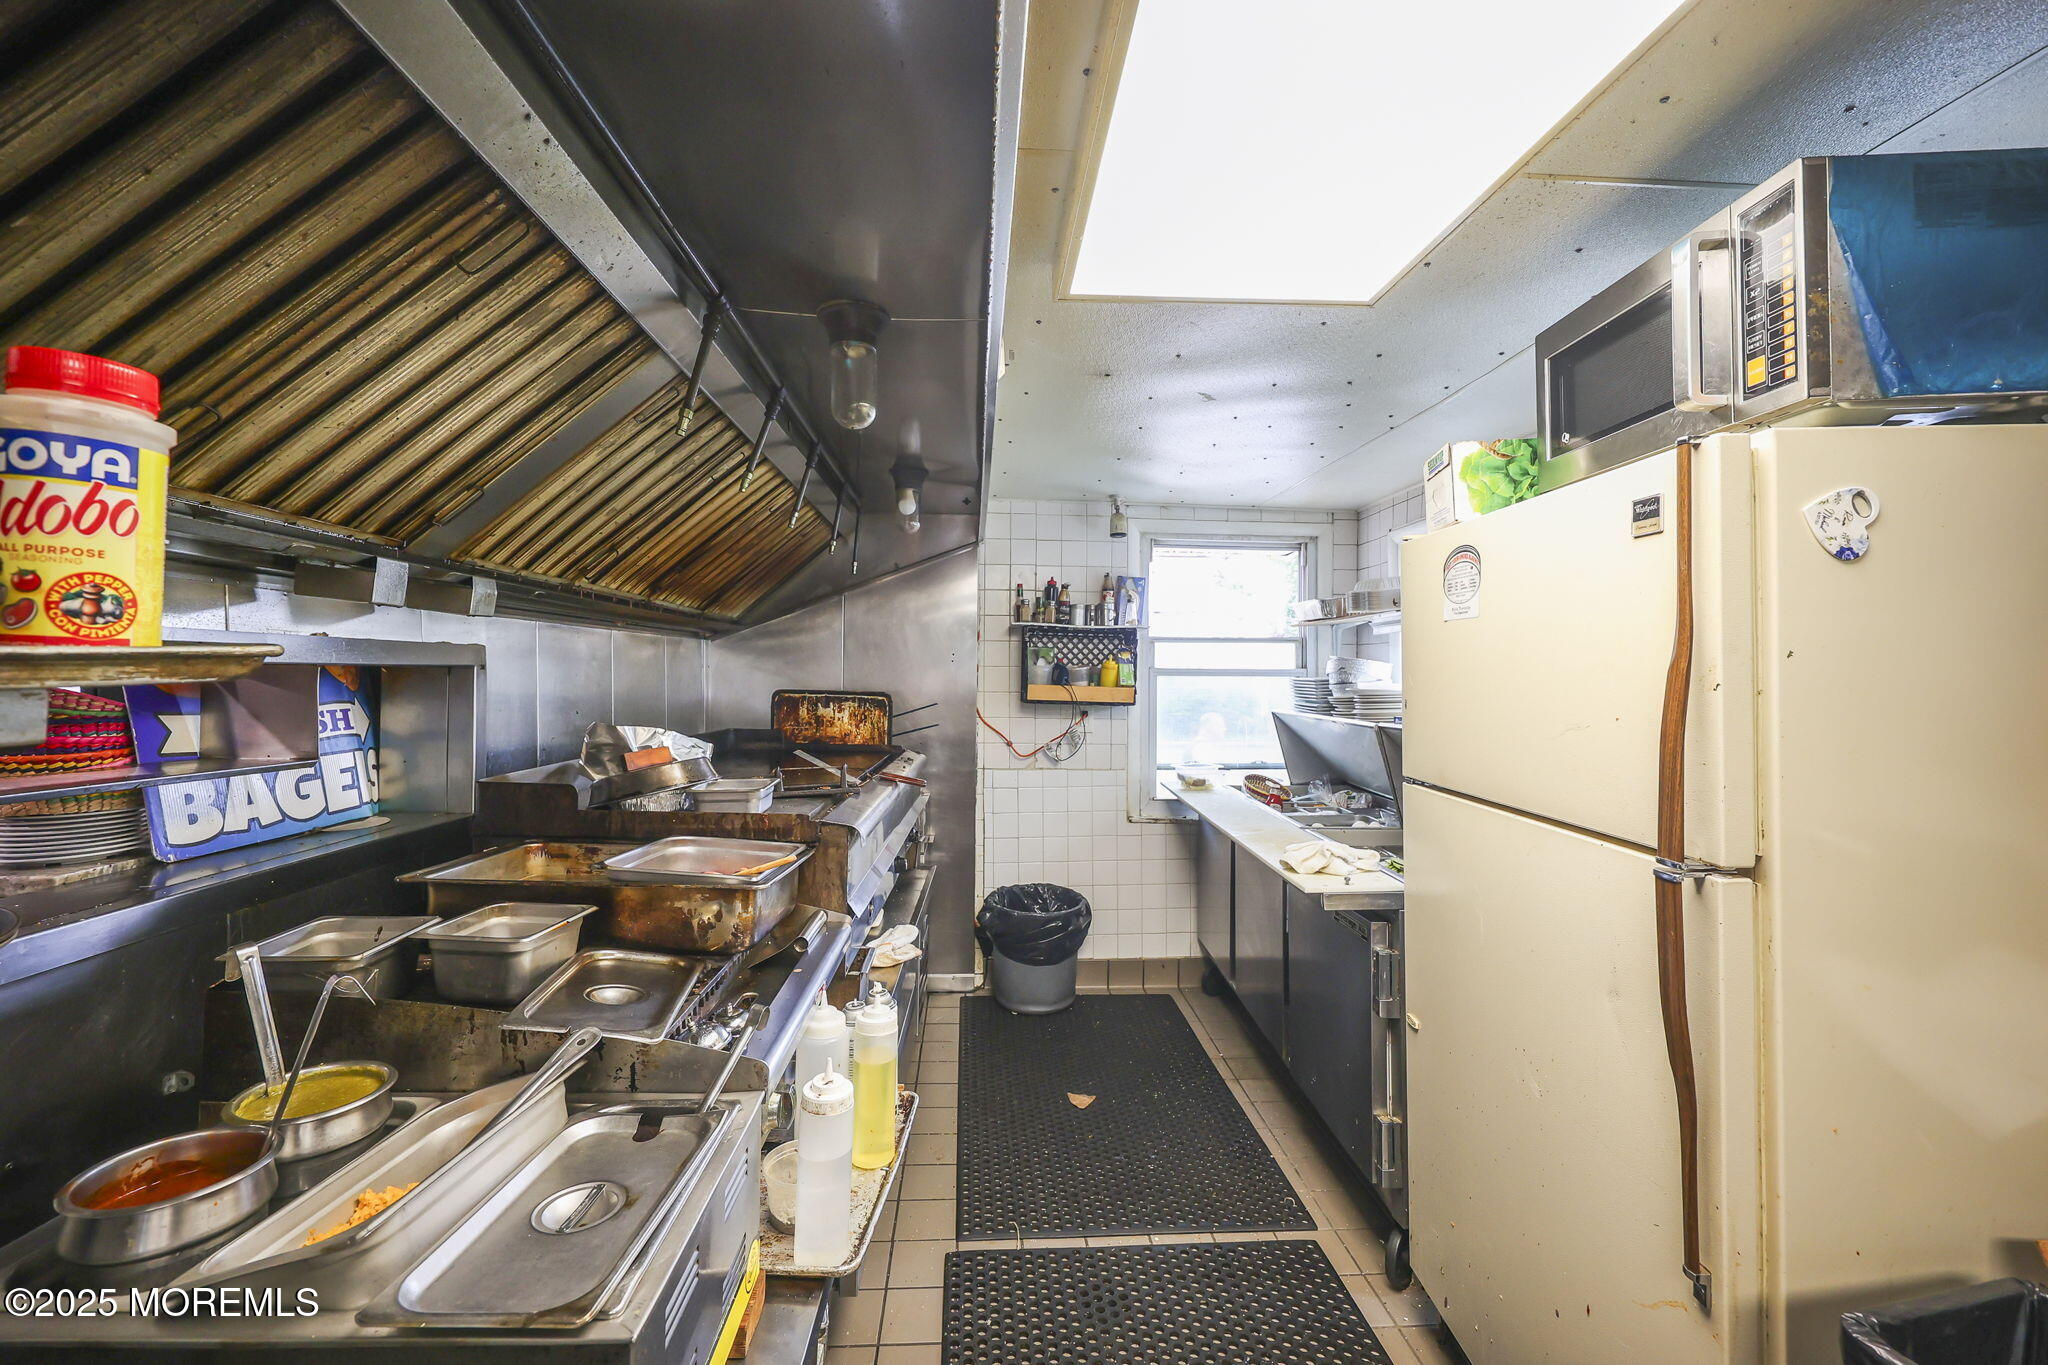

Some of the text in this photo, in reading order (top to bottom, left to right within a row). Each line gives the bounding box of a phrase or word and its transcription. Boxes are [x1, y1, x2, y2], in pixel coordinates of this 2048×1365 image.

[0, 436, 132, 484] OYA
[0, 479, 140, 538] dobo
[8, 552, 84, 566] SEASONING
[23, 543, 106, 559] PURPOSE
[48, 573, 134, 601] WITH PEPPER
[48, 607, 137, 638] CON PIMIENTA
[318, 707, 355, 734] SH
